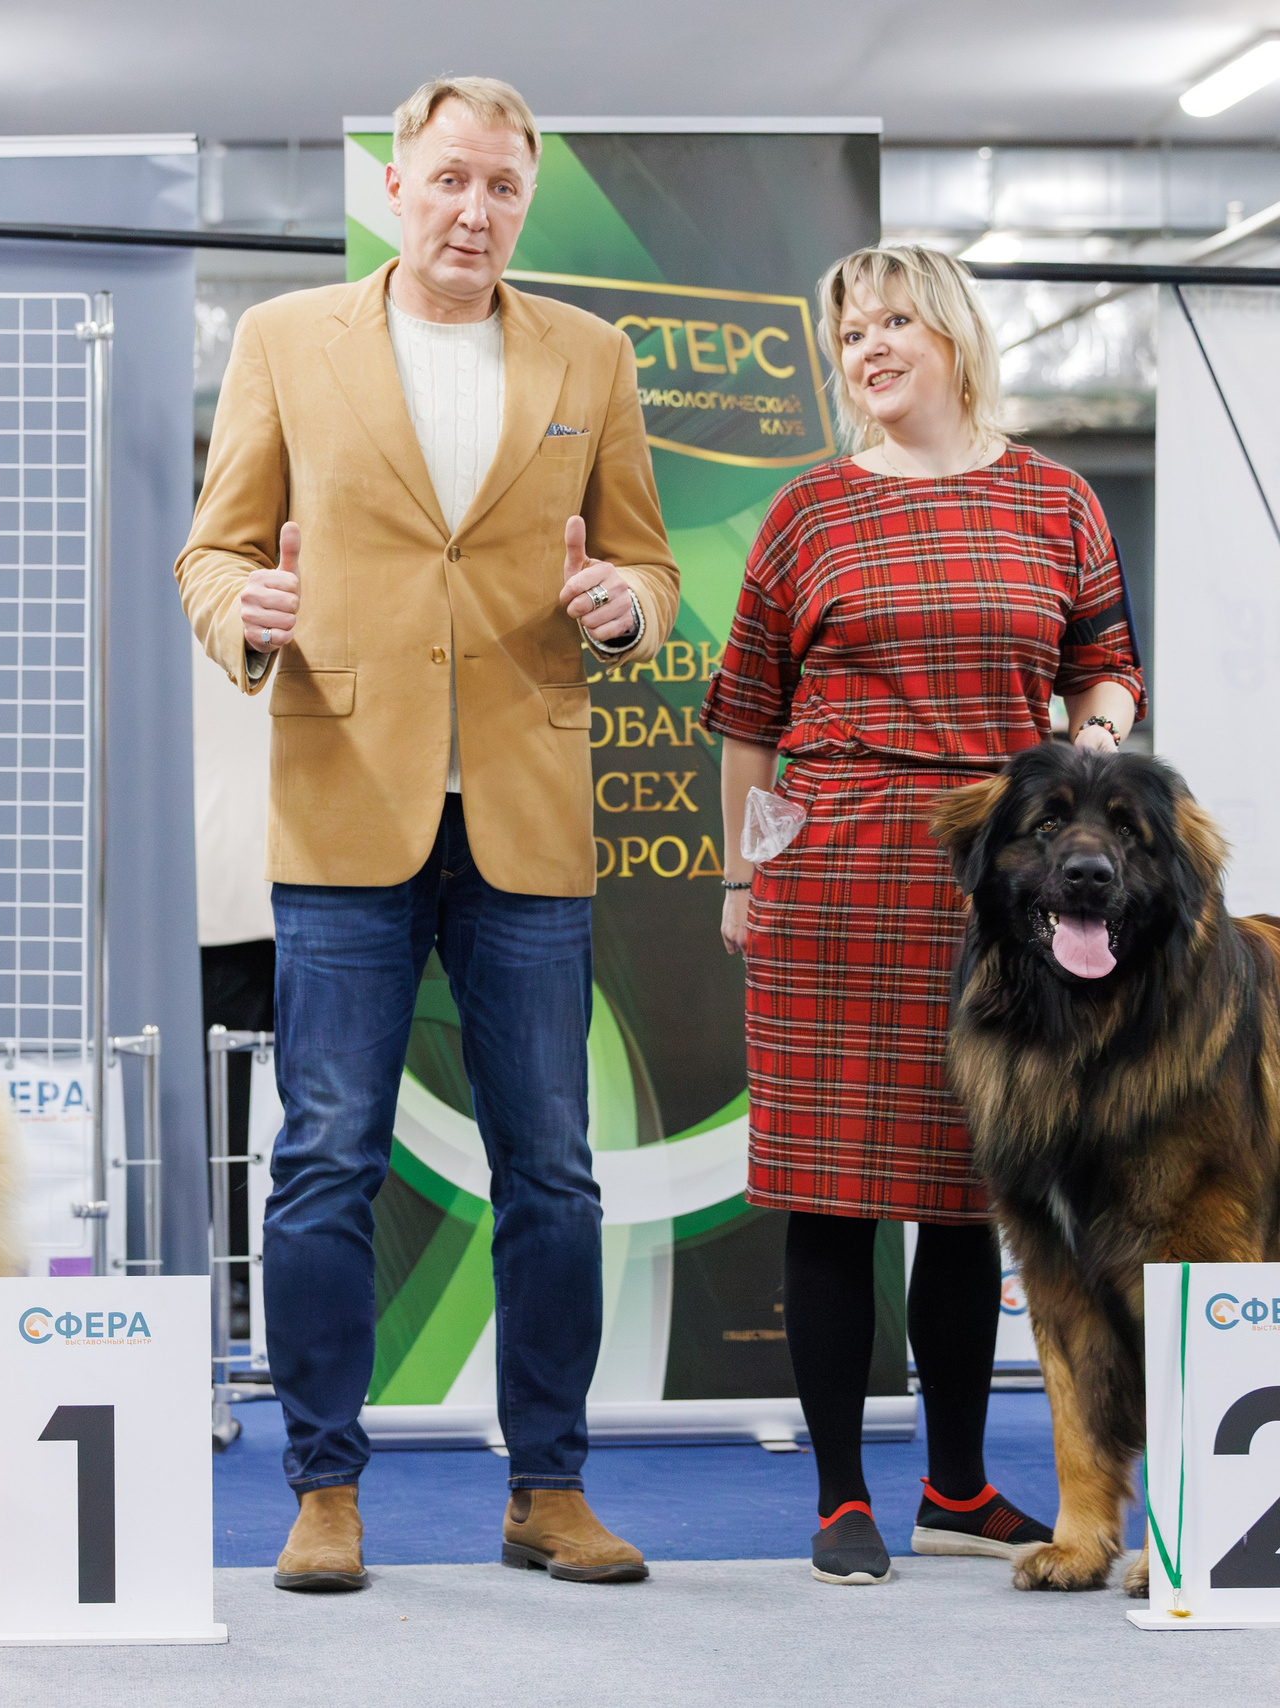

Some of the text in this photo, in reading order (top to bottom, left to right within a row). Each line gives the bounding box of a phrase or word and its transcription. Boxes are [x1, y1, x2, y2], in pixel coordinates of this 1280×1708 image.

[759, 418, 805, 436] КЛУБ
[595, 771, 699, 813] СЕХ
[18, 1307, 152, 1344] СФЕРА
[65, 1338, 152, 1346] ВЫСТАВОЧНЫЙ ЦЕНТР
[37, 1404, 116, 1604] 1
[1210, 1385, 1280, 1589] 2
